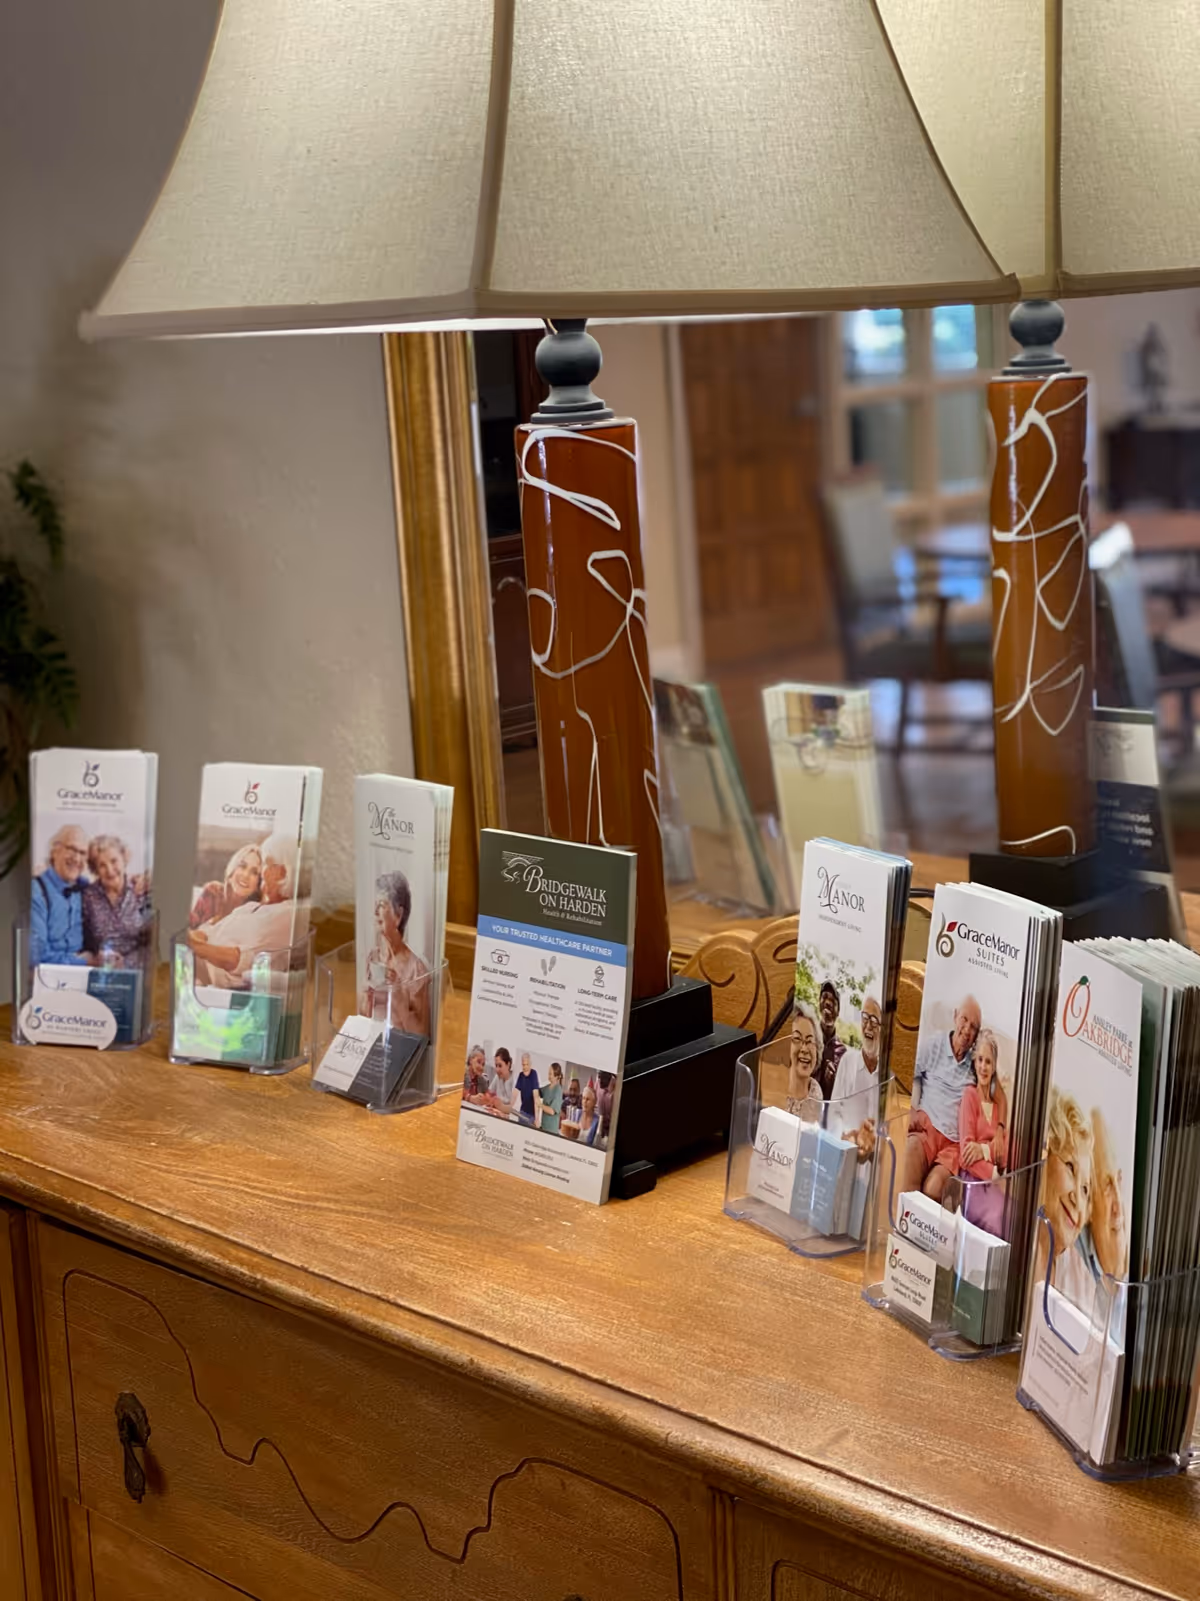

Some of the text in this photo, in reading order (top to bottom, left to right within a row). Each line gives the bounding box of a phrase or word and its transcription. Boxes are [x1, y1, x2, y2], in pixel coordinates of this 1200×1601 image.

[57, 788, 124, 800] GraceManor
[222, 803, 277, 816] GraceManor
[368, 801, 415, 840] MANOR
[523, 865, 607, 903] BRIDGEWALK
[817, 866, 865, 914] MANOR
[540, 893, 607, 918] ON HARDEN
[492, 925, 612, 957] YOUR TRUSTED HEALTHCARE PARTNER
[957, 923, 1020, 960] GraceManor
[968, 957, 1009, 979] ASSISTED LIVING
[976, 947, 1005, 967] SUITES
[529, 977, 566, 990] REHABILITATION
[604, 993, 618, 1002] CARE
[42, 1012, 107, 1027] GraceManor
[1063, 979, 1133, 1068] OAKBRIDGE
[909, 1213, 949, 1247] GraceManor
[897, 1258, 932, 1285] GraceManor
